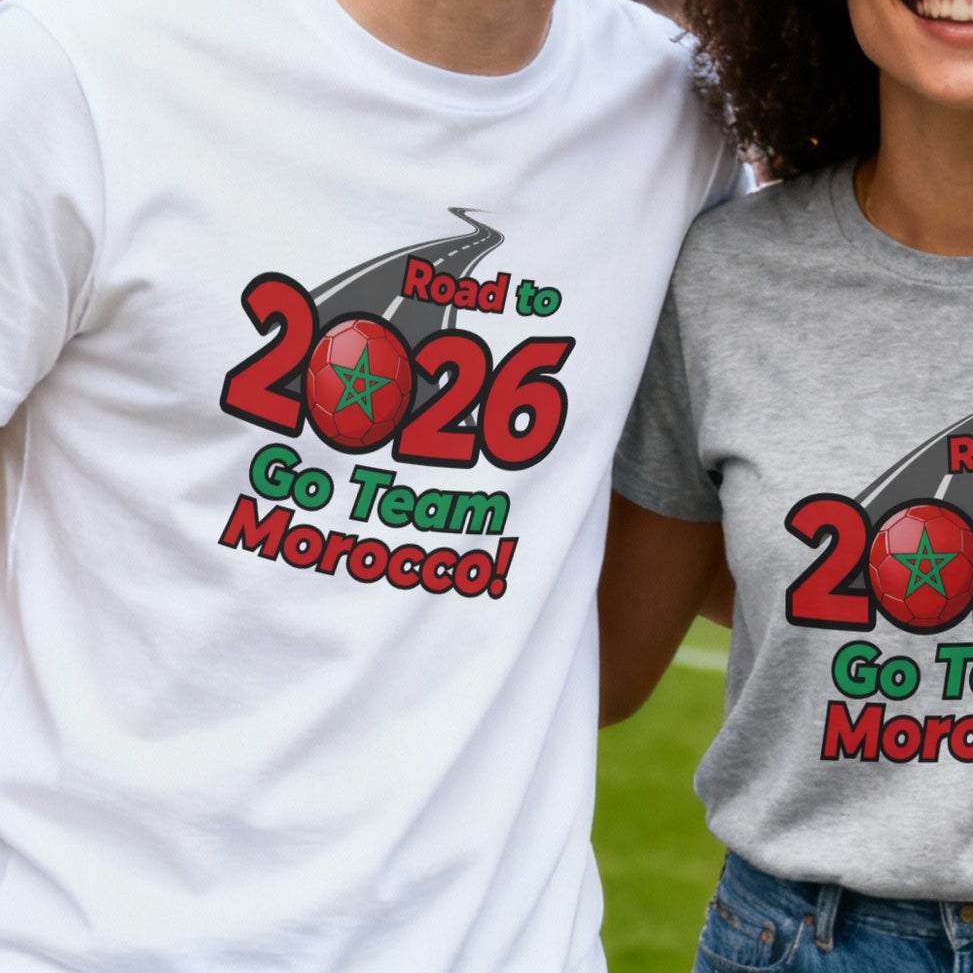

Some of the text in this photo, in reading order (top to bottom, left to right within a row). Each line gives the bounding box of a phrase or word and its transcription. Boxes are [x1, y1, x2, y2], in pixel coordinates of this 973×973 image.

[401, 254, 562, 317] Road to
[220, 272, 576, 471] 2026
[250, 443, 510, 535] Go Team
[218, 494, 519, 599] Morocco!
[832, 640, 921, 701] Go
